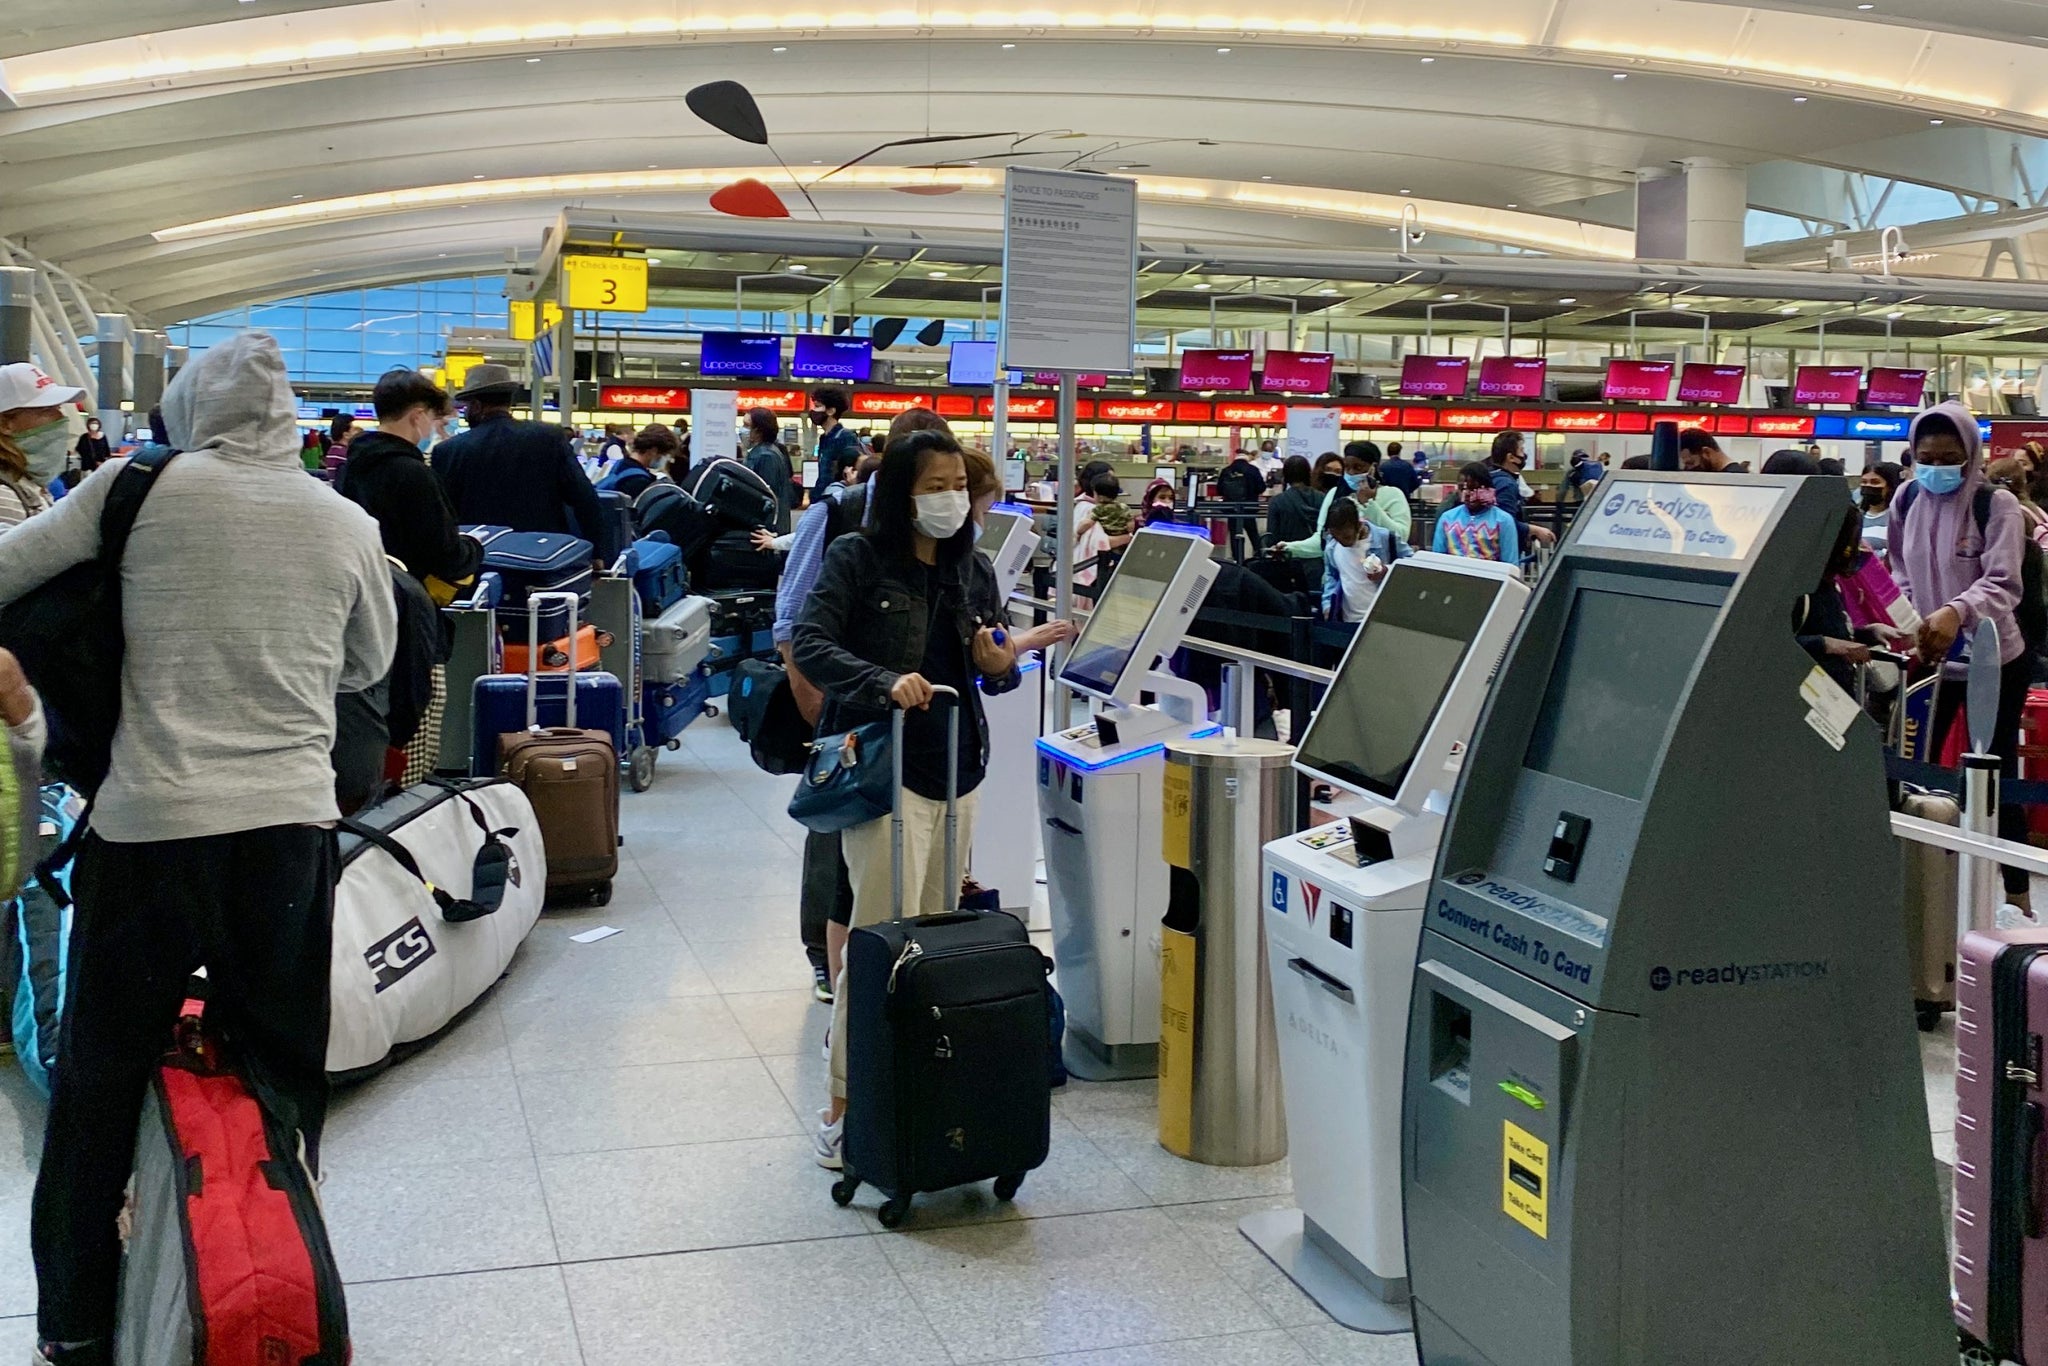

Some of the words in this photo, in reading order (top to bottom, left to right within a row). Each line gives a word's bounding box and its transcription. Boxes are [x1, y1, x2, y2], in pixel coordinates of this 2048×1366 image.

[1012, 184, 1040, 196] ADVICE
[1042, 187, 1053, 197] TO
[1054, 188, 1100, 201] PASSENGERS
[601, 279, 617, 305] 3
[1183, 375, 1204, 386] bag
[1205, 375, 1231, 386] drop
[1264, 376, 1285, 388] bag
[1286, 376, 1311, 388] drop
[1403, 380, 1423, 392] bag
[1424, 380, 1447, 391] drop
[1481, 380, 1501, 392] bag
[1501, 381, 1524, 392] drop
[1606, 384, 1627, 395] bag
[1628, 385, 1651, 396] drop
[1680, 387, 1699, 398] bag
[1701, 388, 1722, 399] drop
[1796, 389, 1816, 400] bag
[1818, 390, 1840, 401] drop
[1868, 390, 1887, 400] bag
[1888, 391, 1907, 401] drop
[1289, 436, 1308, 448] Bag
[1608, 523, 1651, 538] Convert
[1684, 529, 1697, 541] To
[1698, 530, 1728, 544] Card
[1437, 899, 1490, 939] Convert
[1492, 923, 1529, 956] Cash
[1533, 940, 1549, 966] To
[1552, 950, 1593, 986] Card
[1508, 1136, 1526, 1155] Take
[1526, 1147, 1544, 1167] Card
[1507, 1191, 1525, 1211] Take
[1524, 1202, 1543, 1223] Card
